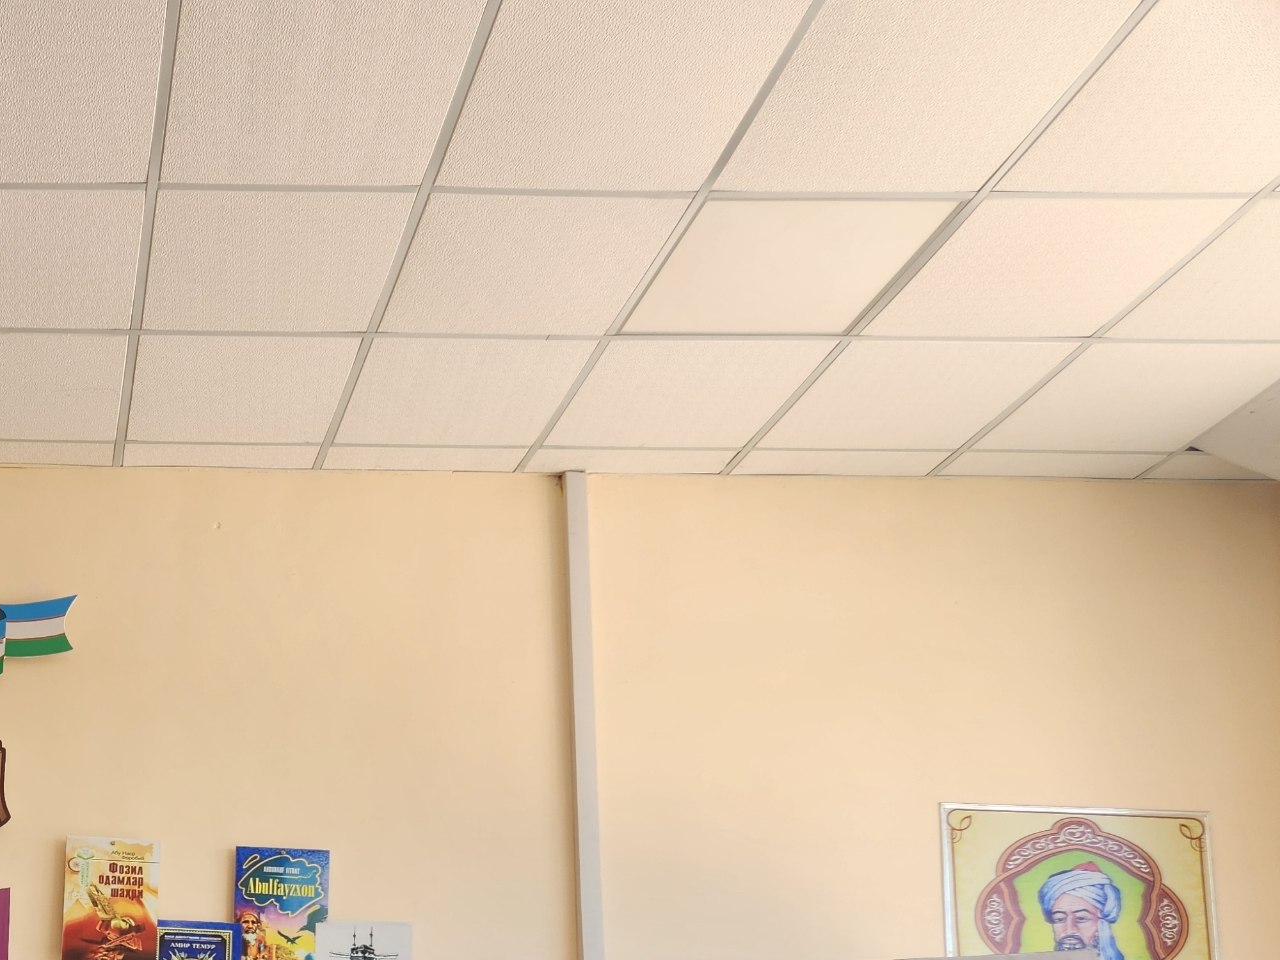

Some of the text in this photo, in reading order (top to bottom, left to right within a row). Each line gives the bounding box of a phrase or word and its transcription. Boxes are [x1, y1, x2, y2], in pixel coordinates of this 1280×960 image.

[108, 862, 143, 876] Фозил
[98, 875, 144, 888] одамлар
[247, 878, 315, 900] Abulfayzxon
